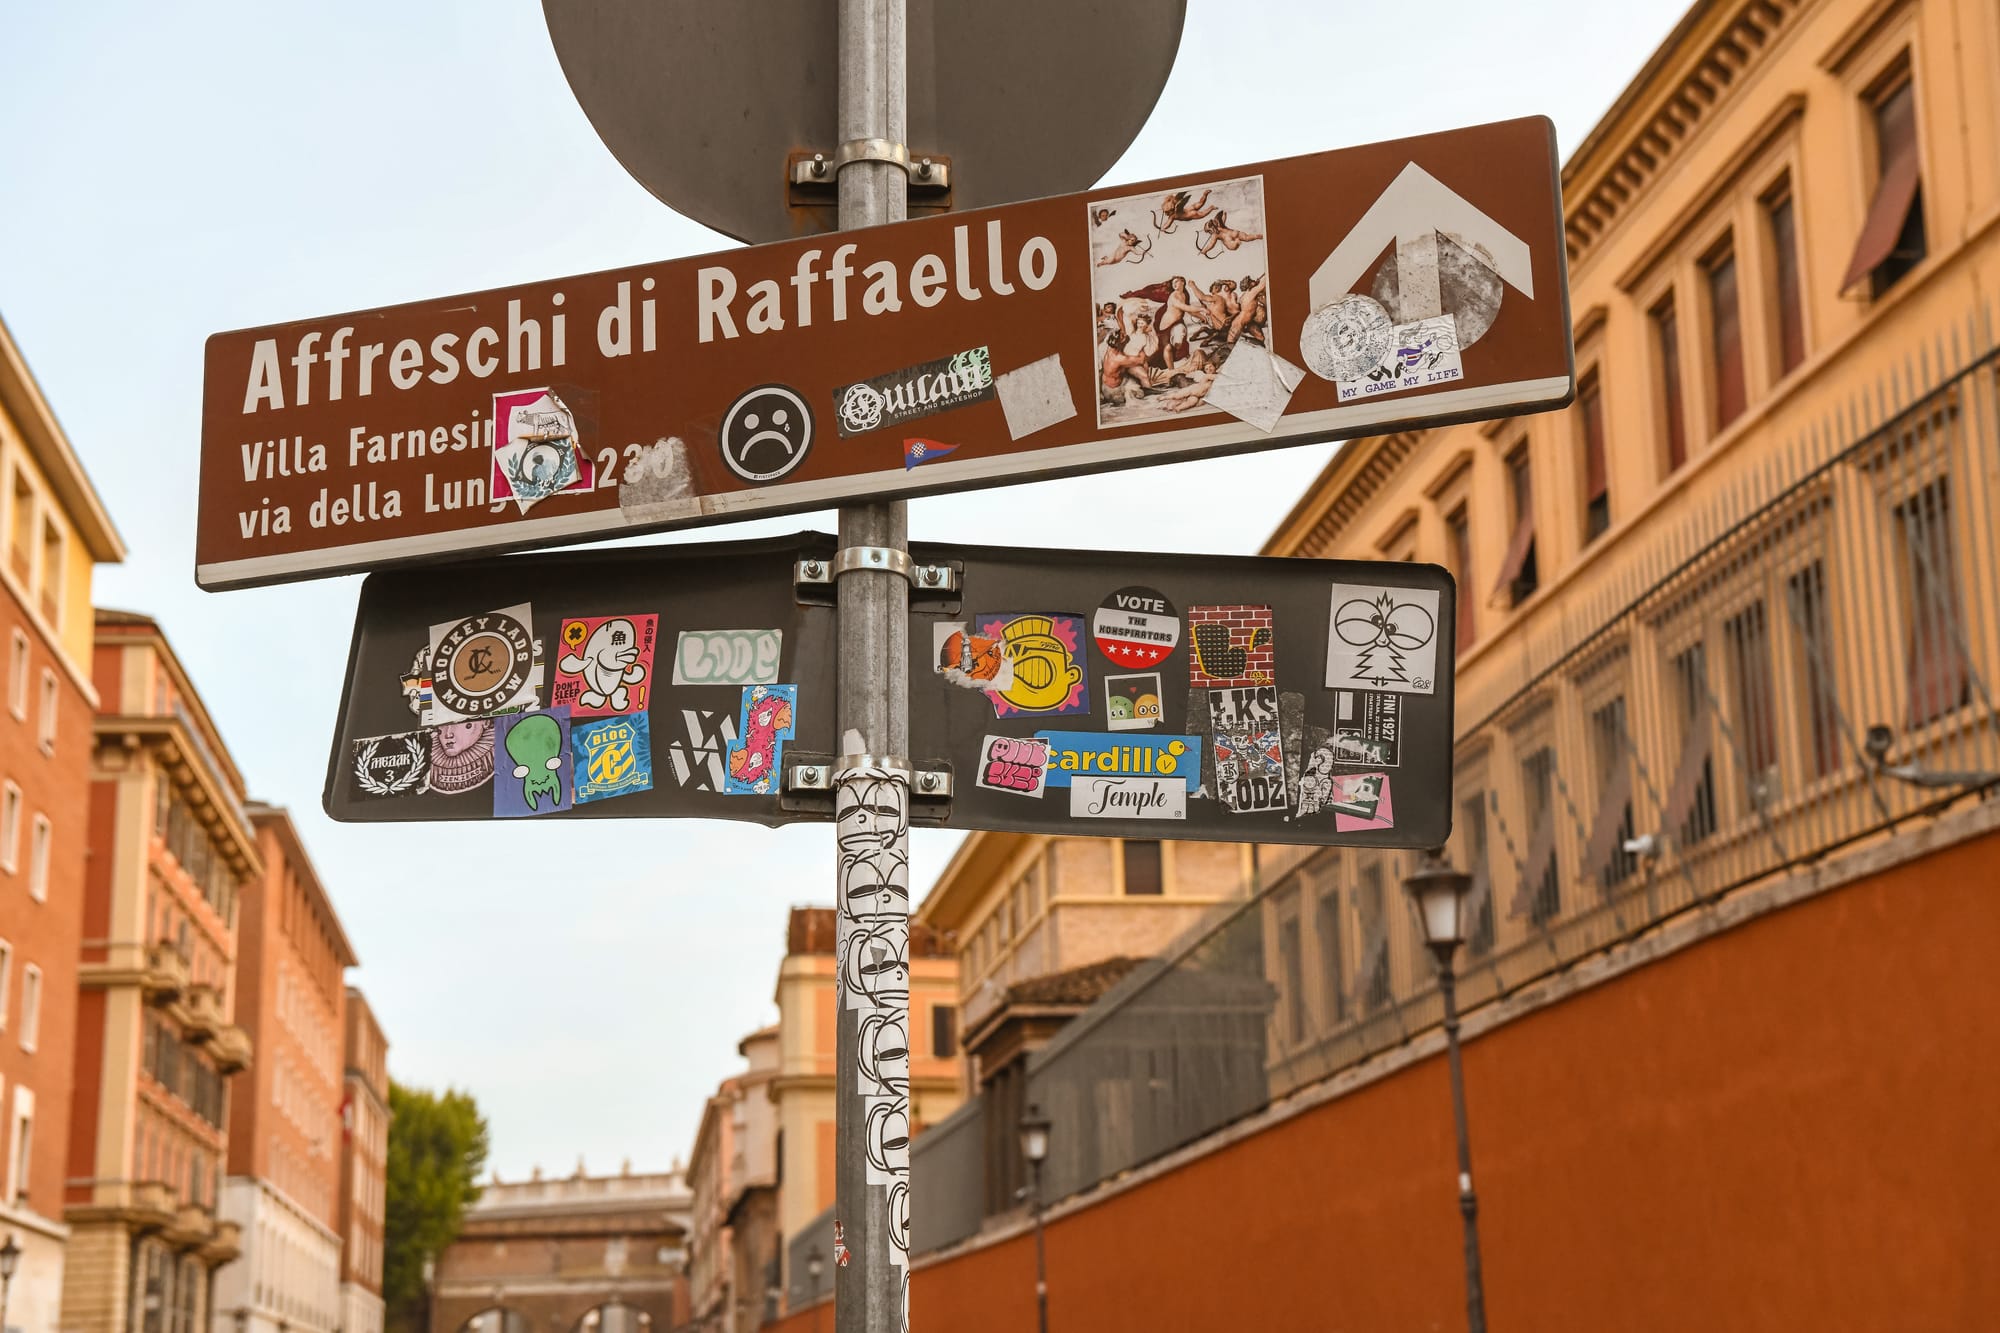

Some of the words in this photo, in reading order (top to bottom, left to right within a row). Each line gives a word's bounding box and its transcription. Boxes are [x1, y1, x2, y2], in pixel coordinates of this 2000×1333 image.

[242, 293, 566, 414] Affreschi
[597, 277, 656, 358] di
[698, 220, 1057, 343] Raffaello
[1342, 388, 1357, 398] MY
[1365, 381, 1396, 393] GAME
[1403, 376, 1419, 386] MY
[1428, 368, 1459, 382] LIFE
[894, 405, 922, 418] STREET
[923, 402, 938, 411] AND
[941, 391, 983, 406] SKATESHOP
[241, 438, 327, 482] Villa
[239, 503, 291, 539] via
[309, 482, 402, 528] della
[1116, 594, 1166, 613] VOTE
[1128, 616, 1147, 626] THE
[435, 617, 489, 682] HOCKEY
[497, 620, 528, 662] LADS
[611, 630, 626, 646] 魚
[441, 673, 523, 712] MOSCOW
[555, 689, 580, 700] SLEEP
[556, 681, 580, 691] DON'T
[1383, 694, 1396, 714] FINI
[592, 728, 628, 746] BLOC
[1382, 717, 1395, 741] 1927
[385, 769, 395, 783] 3
[1088, 778, 1168, 816] Temple
